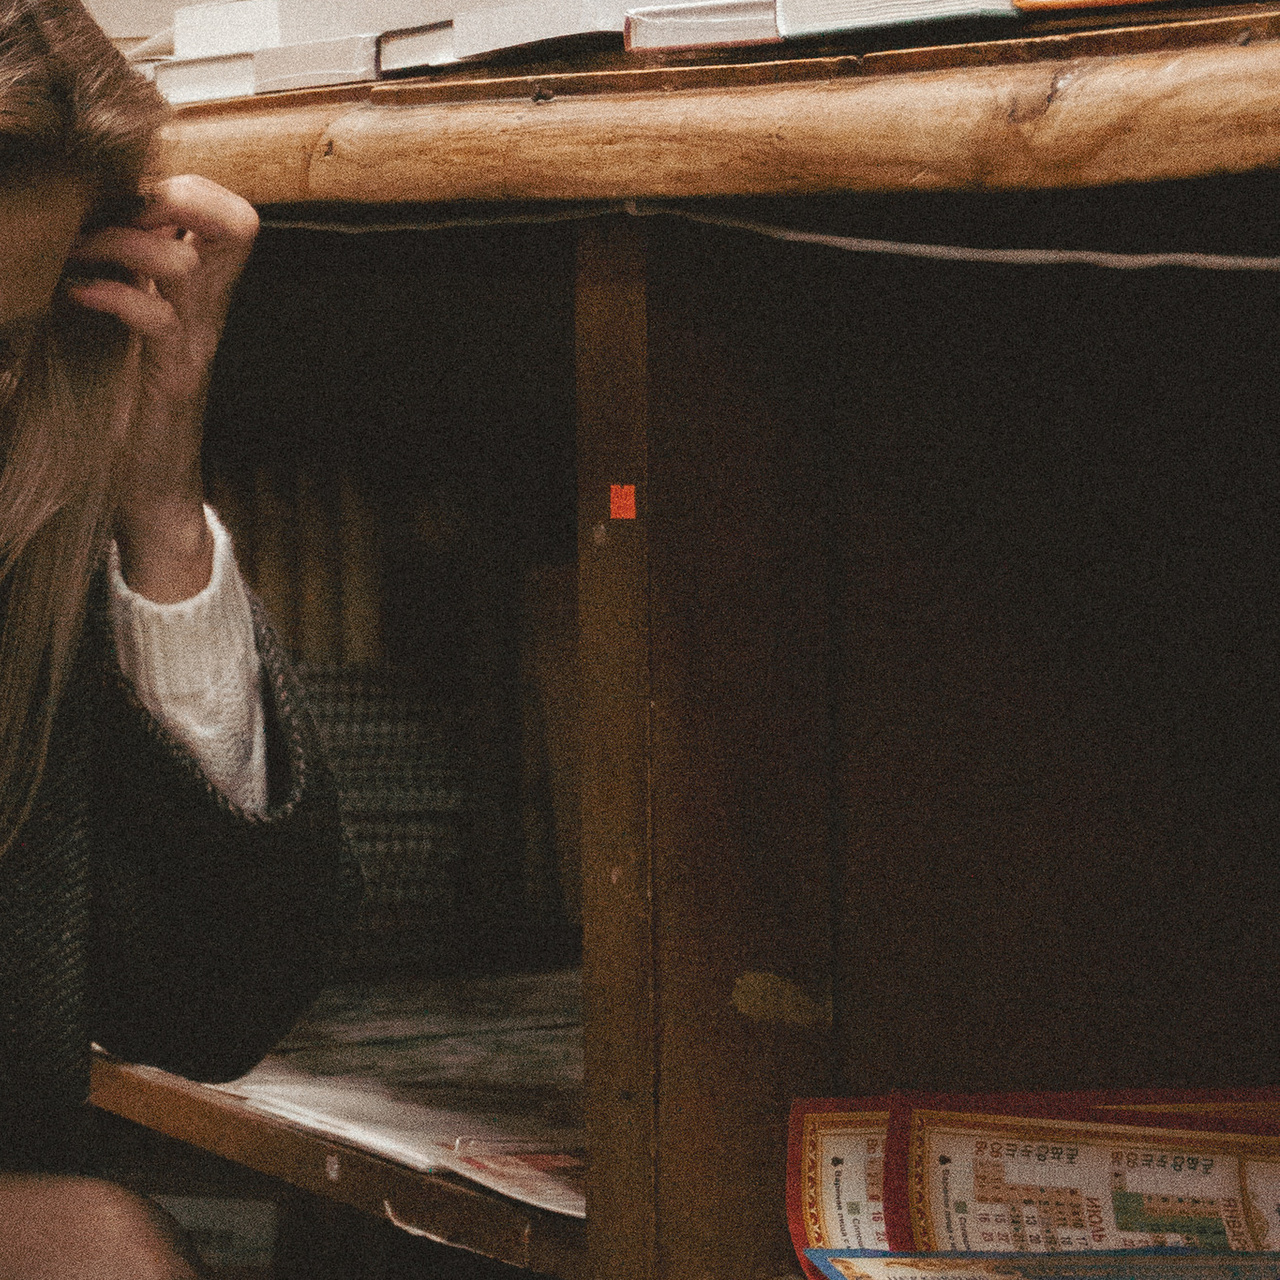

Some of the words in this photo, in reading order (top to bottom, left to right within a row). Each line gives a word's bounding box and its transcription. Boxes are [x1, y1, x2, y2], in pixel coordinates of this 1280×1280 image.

[990, 1142, 1002, 1158] Сб
[1006, 1143, 1018, 1158] Пт
[1021, 1145, 1033, 1158] Чт
[1036, 1146, 1049, 1162] Ср
[1051, 1147, 1063, 1160] Вт
[1142, 1154, 1154, 1167] Пт
[1172, 1156, 1185, 1172] Ср
[1187, 1157, 1199, 1171] Вт
[1202, 1159, 1214, 1175] Пн
[1066, 1148, 1079, 1164] Пн
[1076, 1236, 1089, 1246] 17
[1025, 1215, 1038, 1226] 13
[1086, 1197, 1107, 1243] ИЮЛЬ
